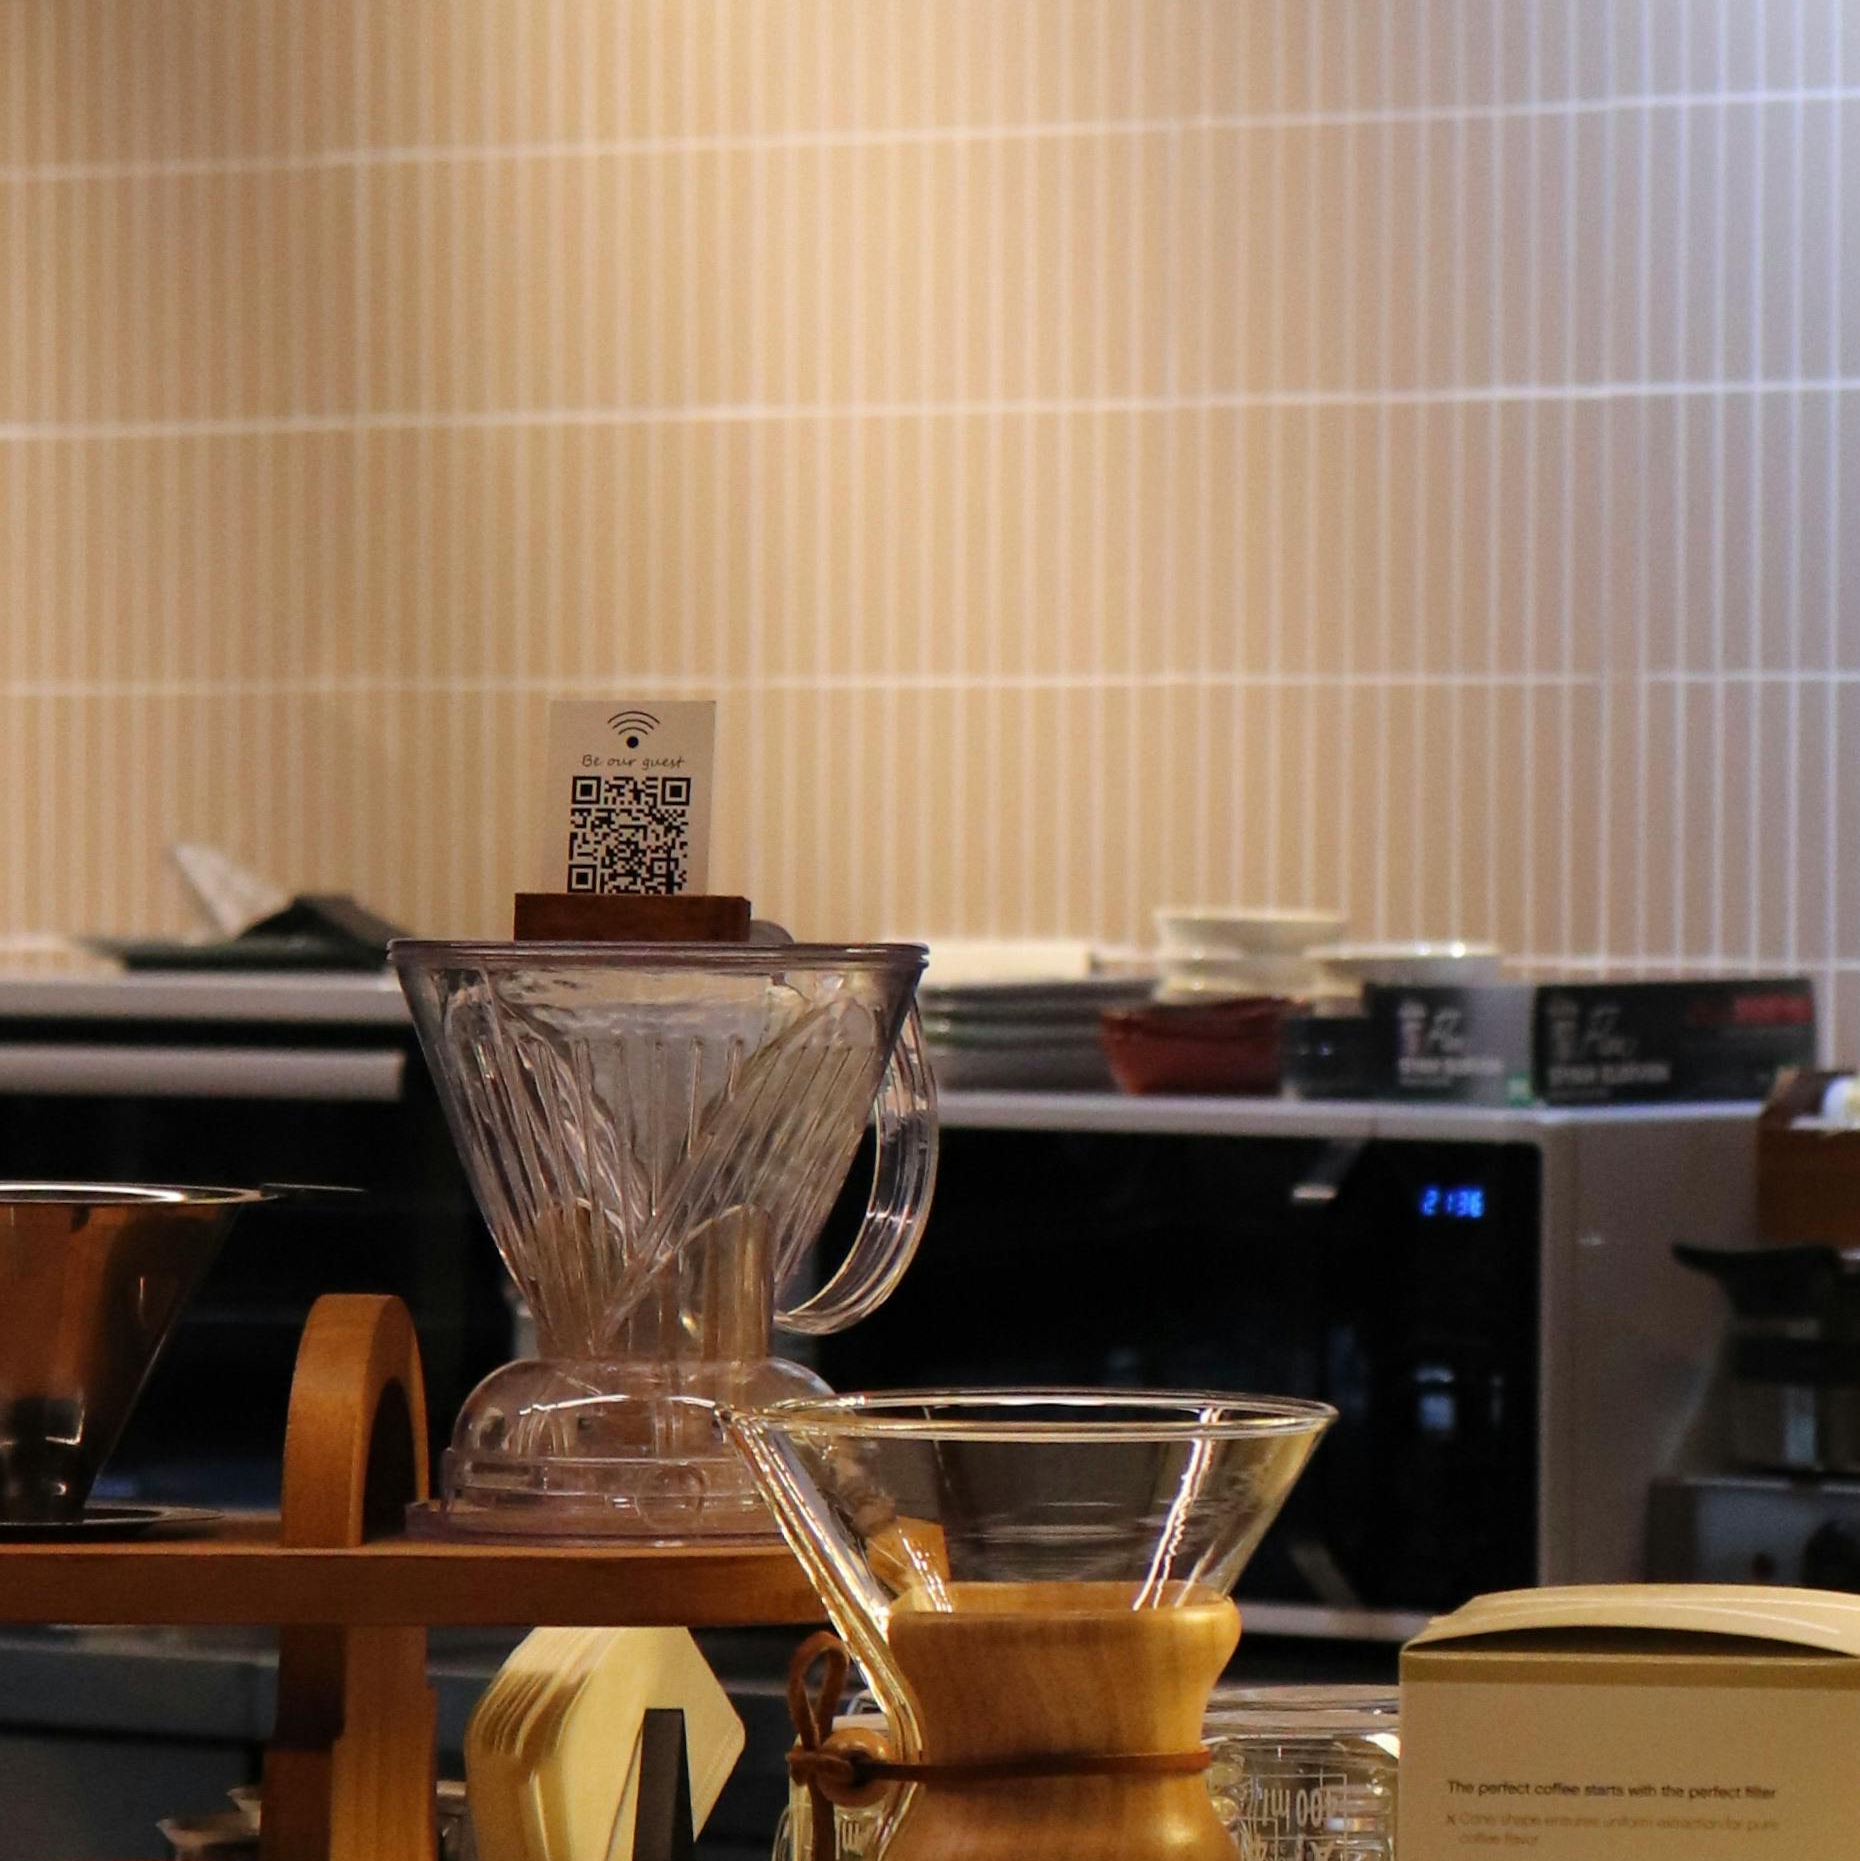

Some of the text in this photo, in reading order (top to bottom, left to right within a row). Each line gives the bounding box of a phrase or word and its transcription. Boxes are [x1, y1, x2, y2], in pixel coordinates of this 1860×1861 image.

[580, 753, 687, 772] Be our guest
[1447, 1780, 1777, 1801] The perfect coffee starts with the perfect filter
